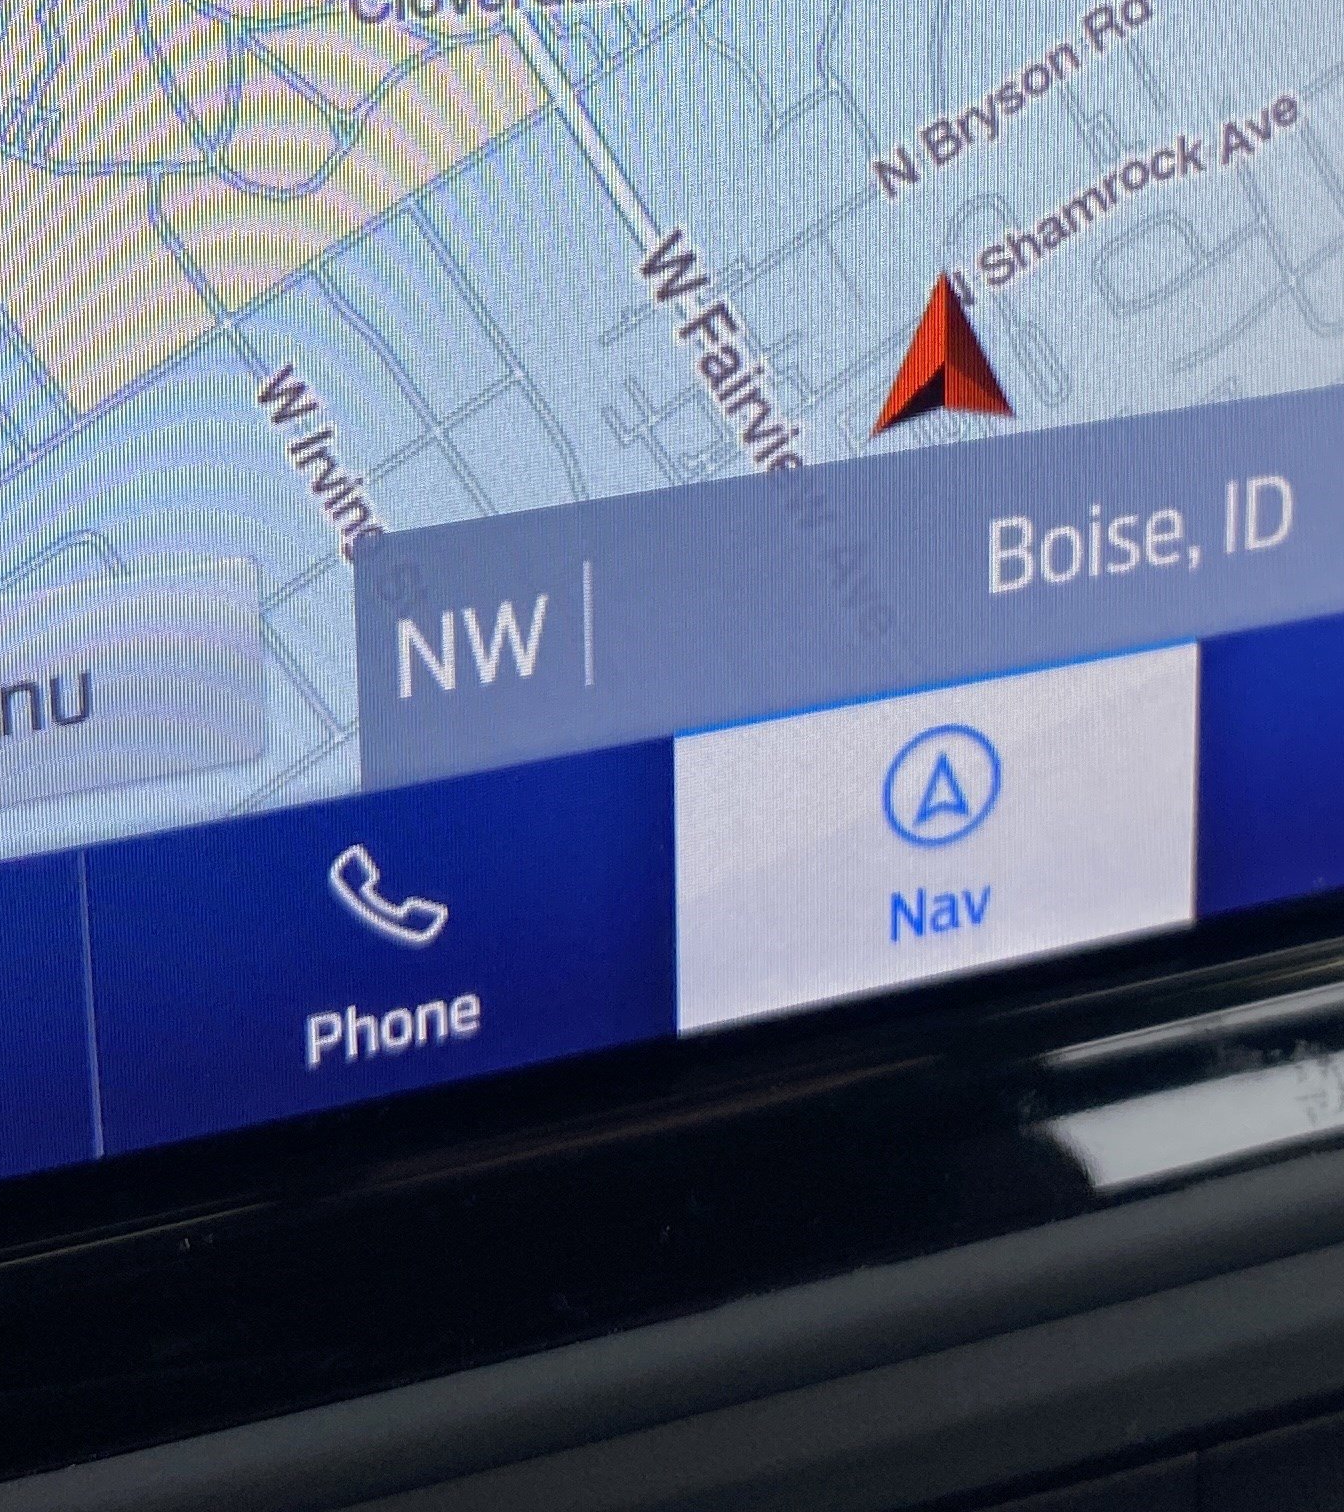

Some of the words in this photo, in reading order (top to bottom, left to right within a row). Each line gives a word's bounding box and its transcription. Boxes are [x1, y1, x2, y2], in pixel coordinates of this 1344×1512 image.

[872, 147, 920, 199] N
[919, 37, 1083, 170] Bryson
[977, 136, 1204, 288] Shamrock
[1217, 90, 1301, 166] Ave
[641, 229, 711, 303] W
[256, 363, 320, 426] W
[987, 503, 1200, 595] Boise,
[1222, 474, 1294, 554] ID
[395, 593, 549, 700] NW
[887, 881, 992, 943] Nav
[306, 988, 482, 1071] Phone
